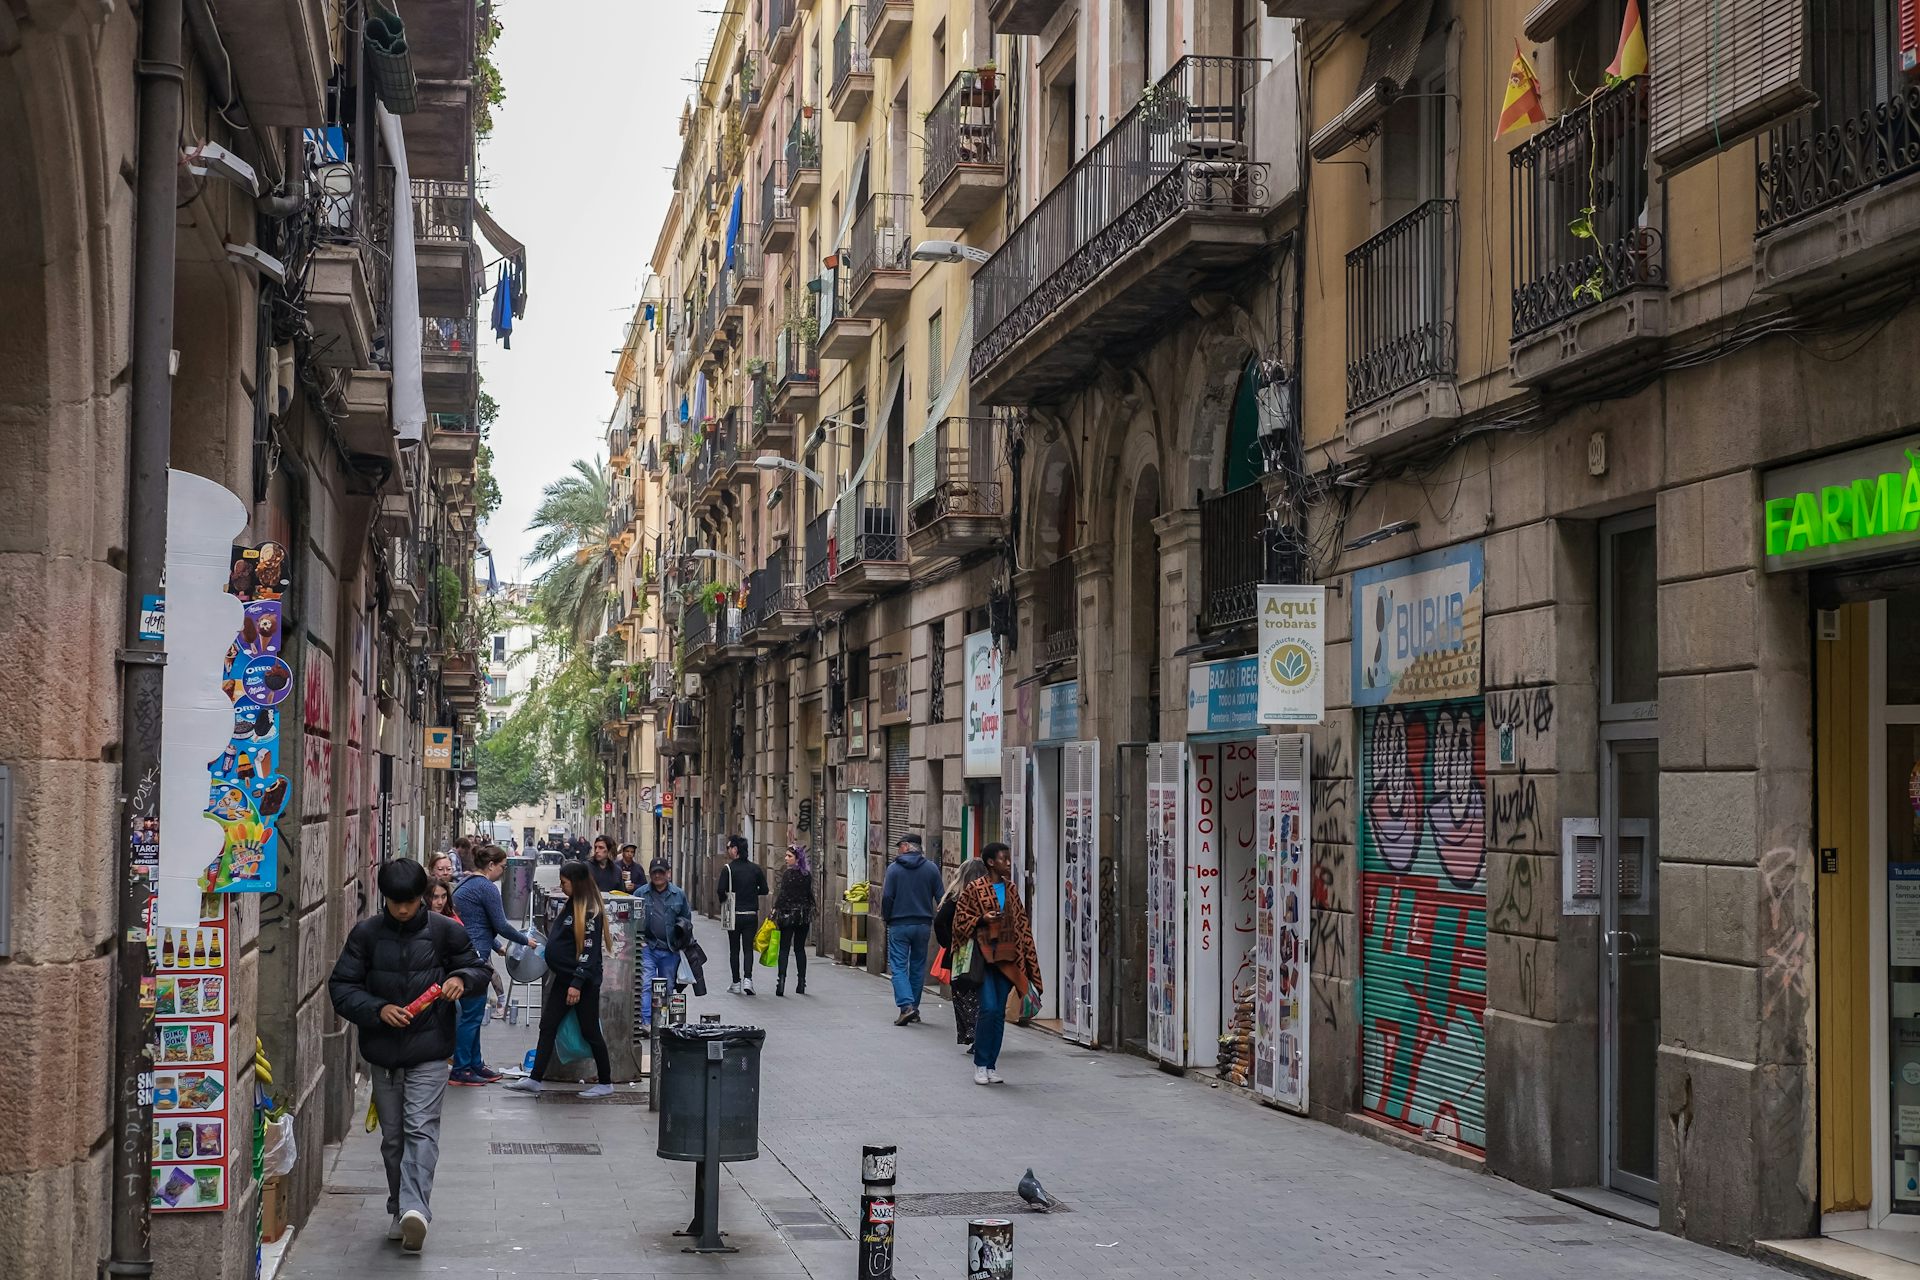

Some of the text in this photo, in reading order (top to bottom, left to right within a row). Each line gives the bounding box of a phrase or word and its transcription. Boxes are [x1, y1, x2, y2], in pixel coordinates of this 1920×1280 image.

[1264, 597, 1317, 619] Aquí
[1264, 619, 1317, 629] trobaràs
[1265, 637, 1317, 656] Producte FRESC
[246, 665, 272, 675] OREO
[1209, 669, 1235, 690] BAZAR
[1240, 665, 1258, 687] REG
[234, 704, 260, 714] OREO
[1196, 755, 1214, 834] TODO
[1201, 841, 1210, 853] A
[1199, 885, 1210, 898] Y
[1201, 904, 1211, 950] MAS
